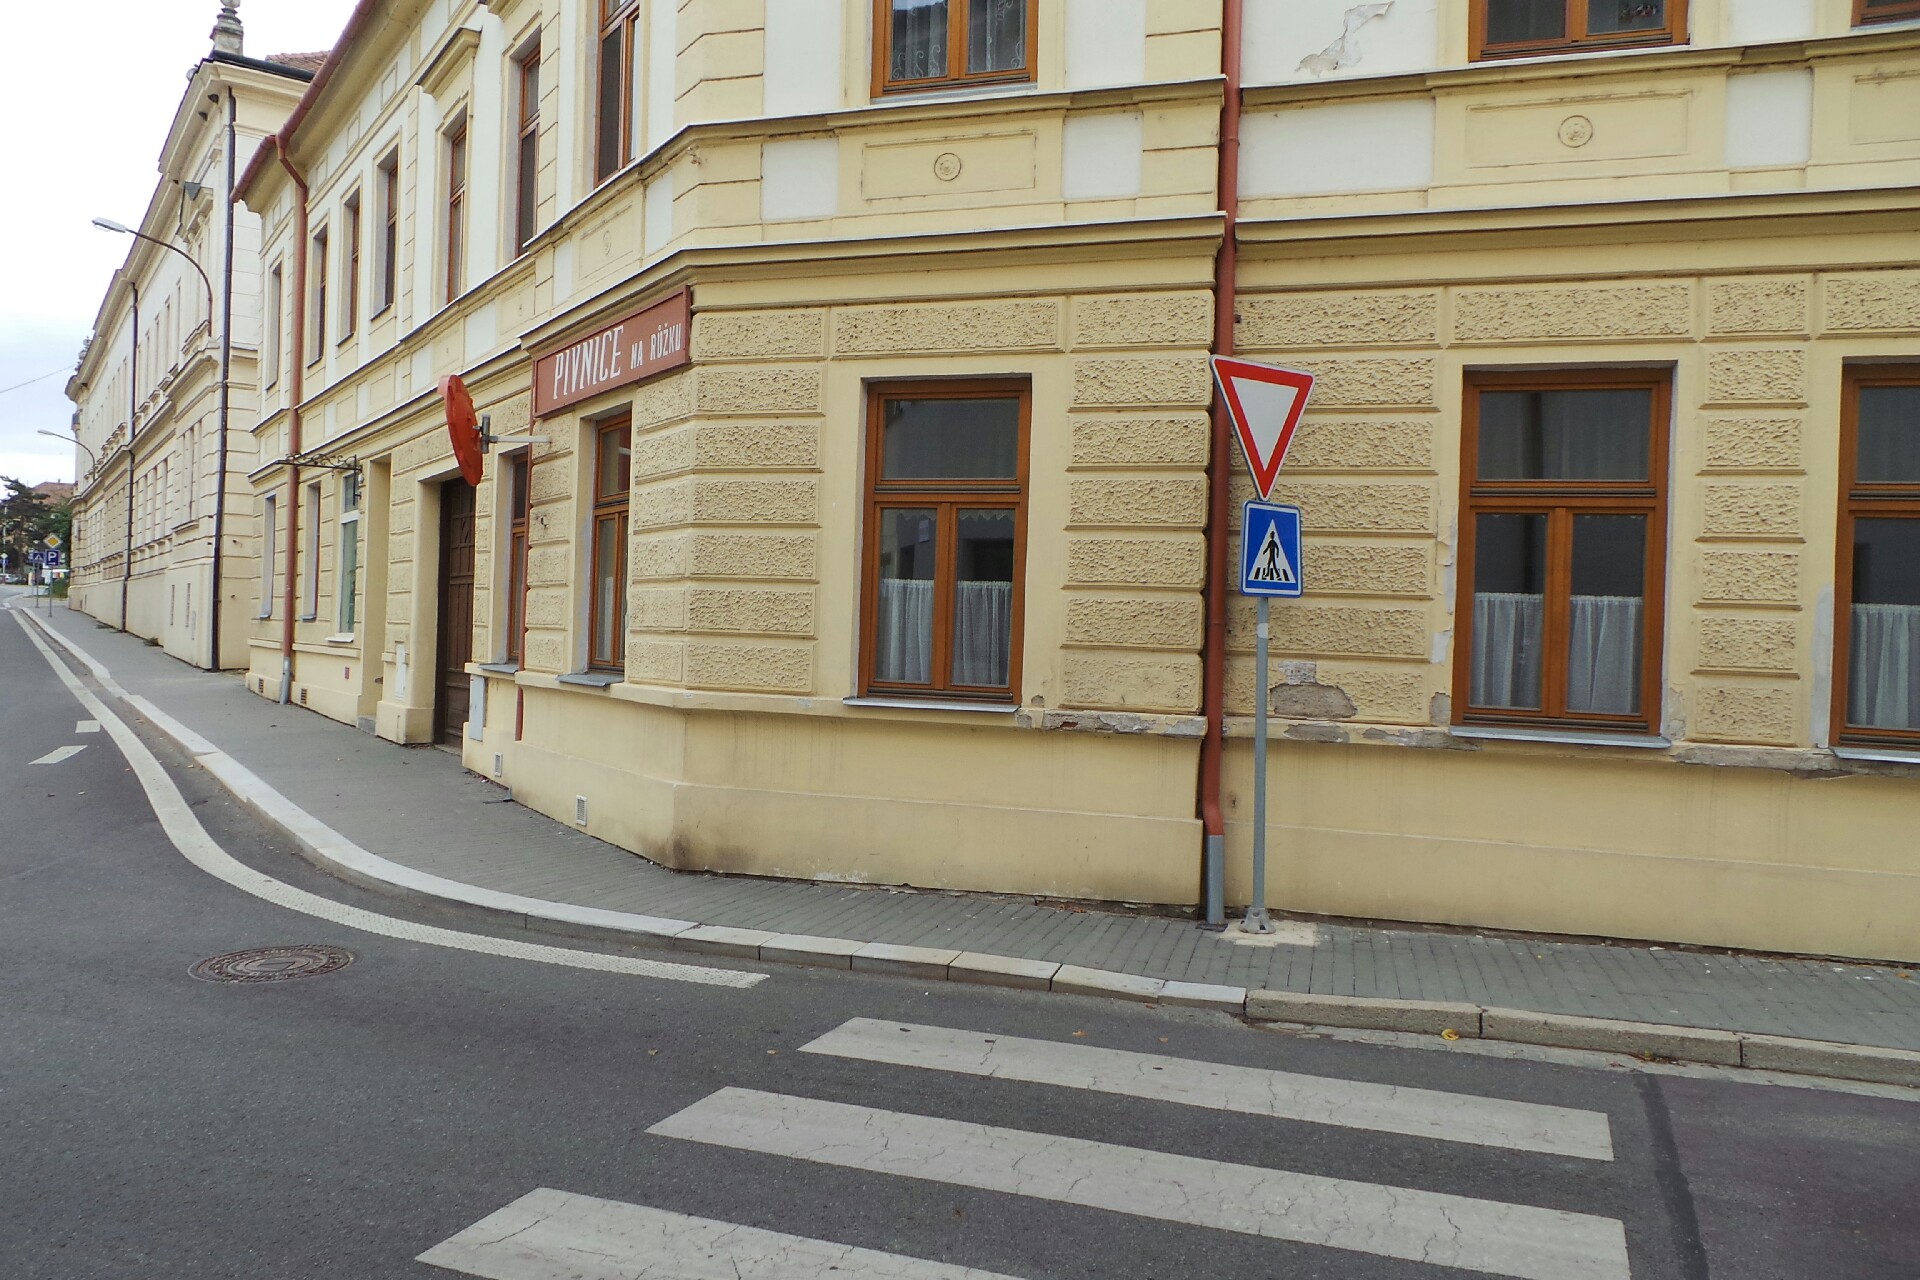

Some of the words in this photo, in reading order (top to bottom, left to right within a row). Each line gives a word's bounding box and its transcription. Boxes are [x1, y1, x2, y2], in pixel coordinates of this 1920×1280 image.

[553, 325, 624, 399] PIVNICE
[630, 341, 643, 369] NA
[650, 323, 682, 361] RŮŽKU
[48, 552, 57, 561] P
